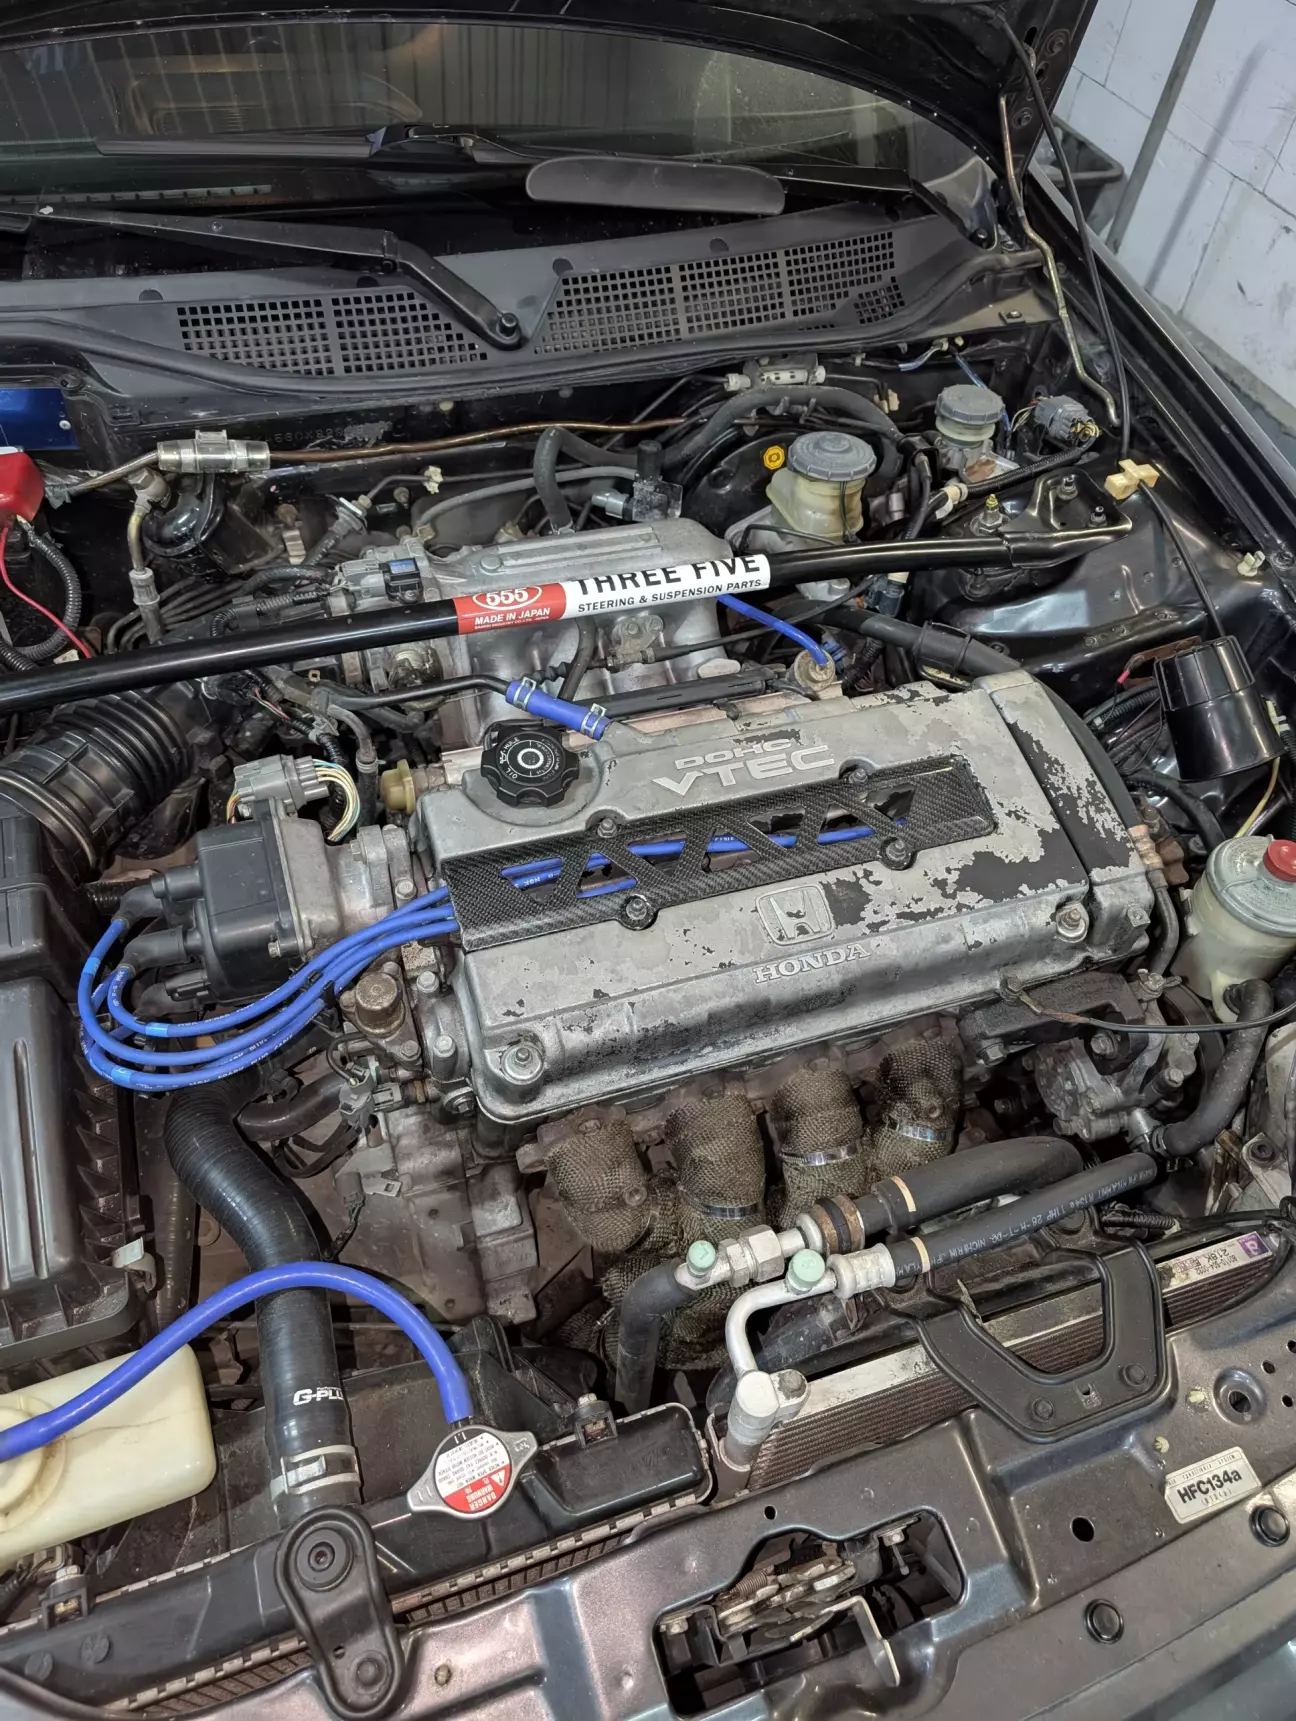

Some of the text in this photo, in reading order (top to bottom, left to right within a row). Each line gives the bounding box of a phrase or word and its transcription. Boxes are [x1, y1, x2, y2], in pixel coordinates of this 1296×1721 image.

[577, 555, 761, 596] THREE FIVE
[485, 587, 529, 606] 555
[577, 579, 762, 613] STEERING & SUSPENSION PARTS
[474, 607, 551, 626] MADE IN JAPAN
[674, 737, 792, 770] DOHC
[651, 744, 835, 797] VTEC
[752, 942, 871, 984] HONDA
[292, 1388, 345, 1406] G-PLU
[453, 1431, 468, 1445] 1.1
[466, 1483, 495, 1503] WARNING
[1176, 1468, 1243, 1504] HFC134a
[468, 1491, 498, 1511] DANGER
